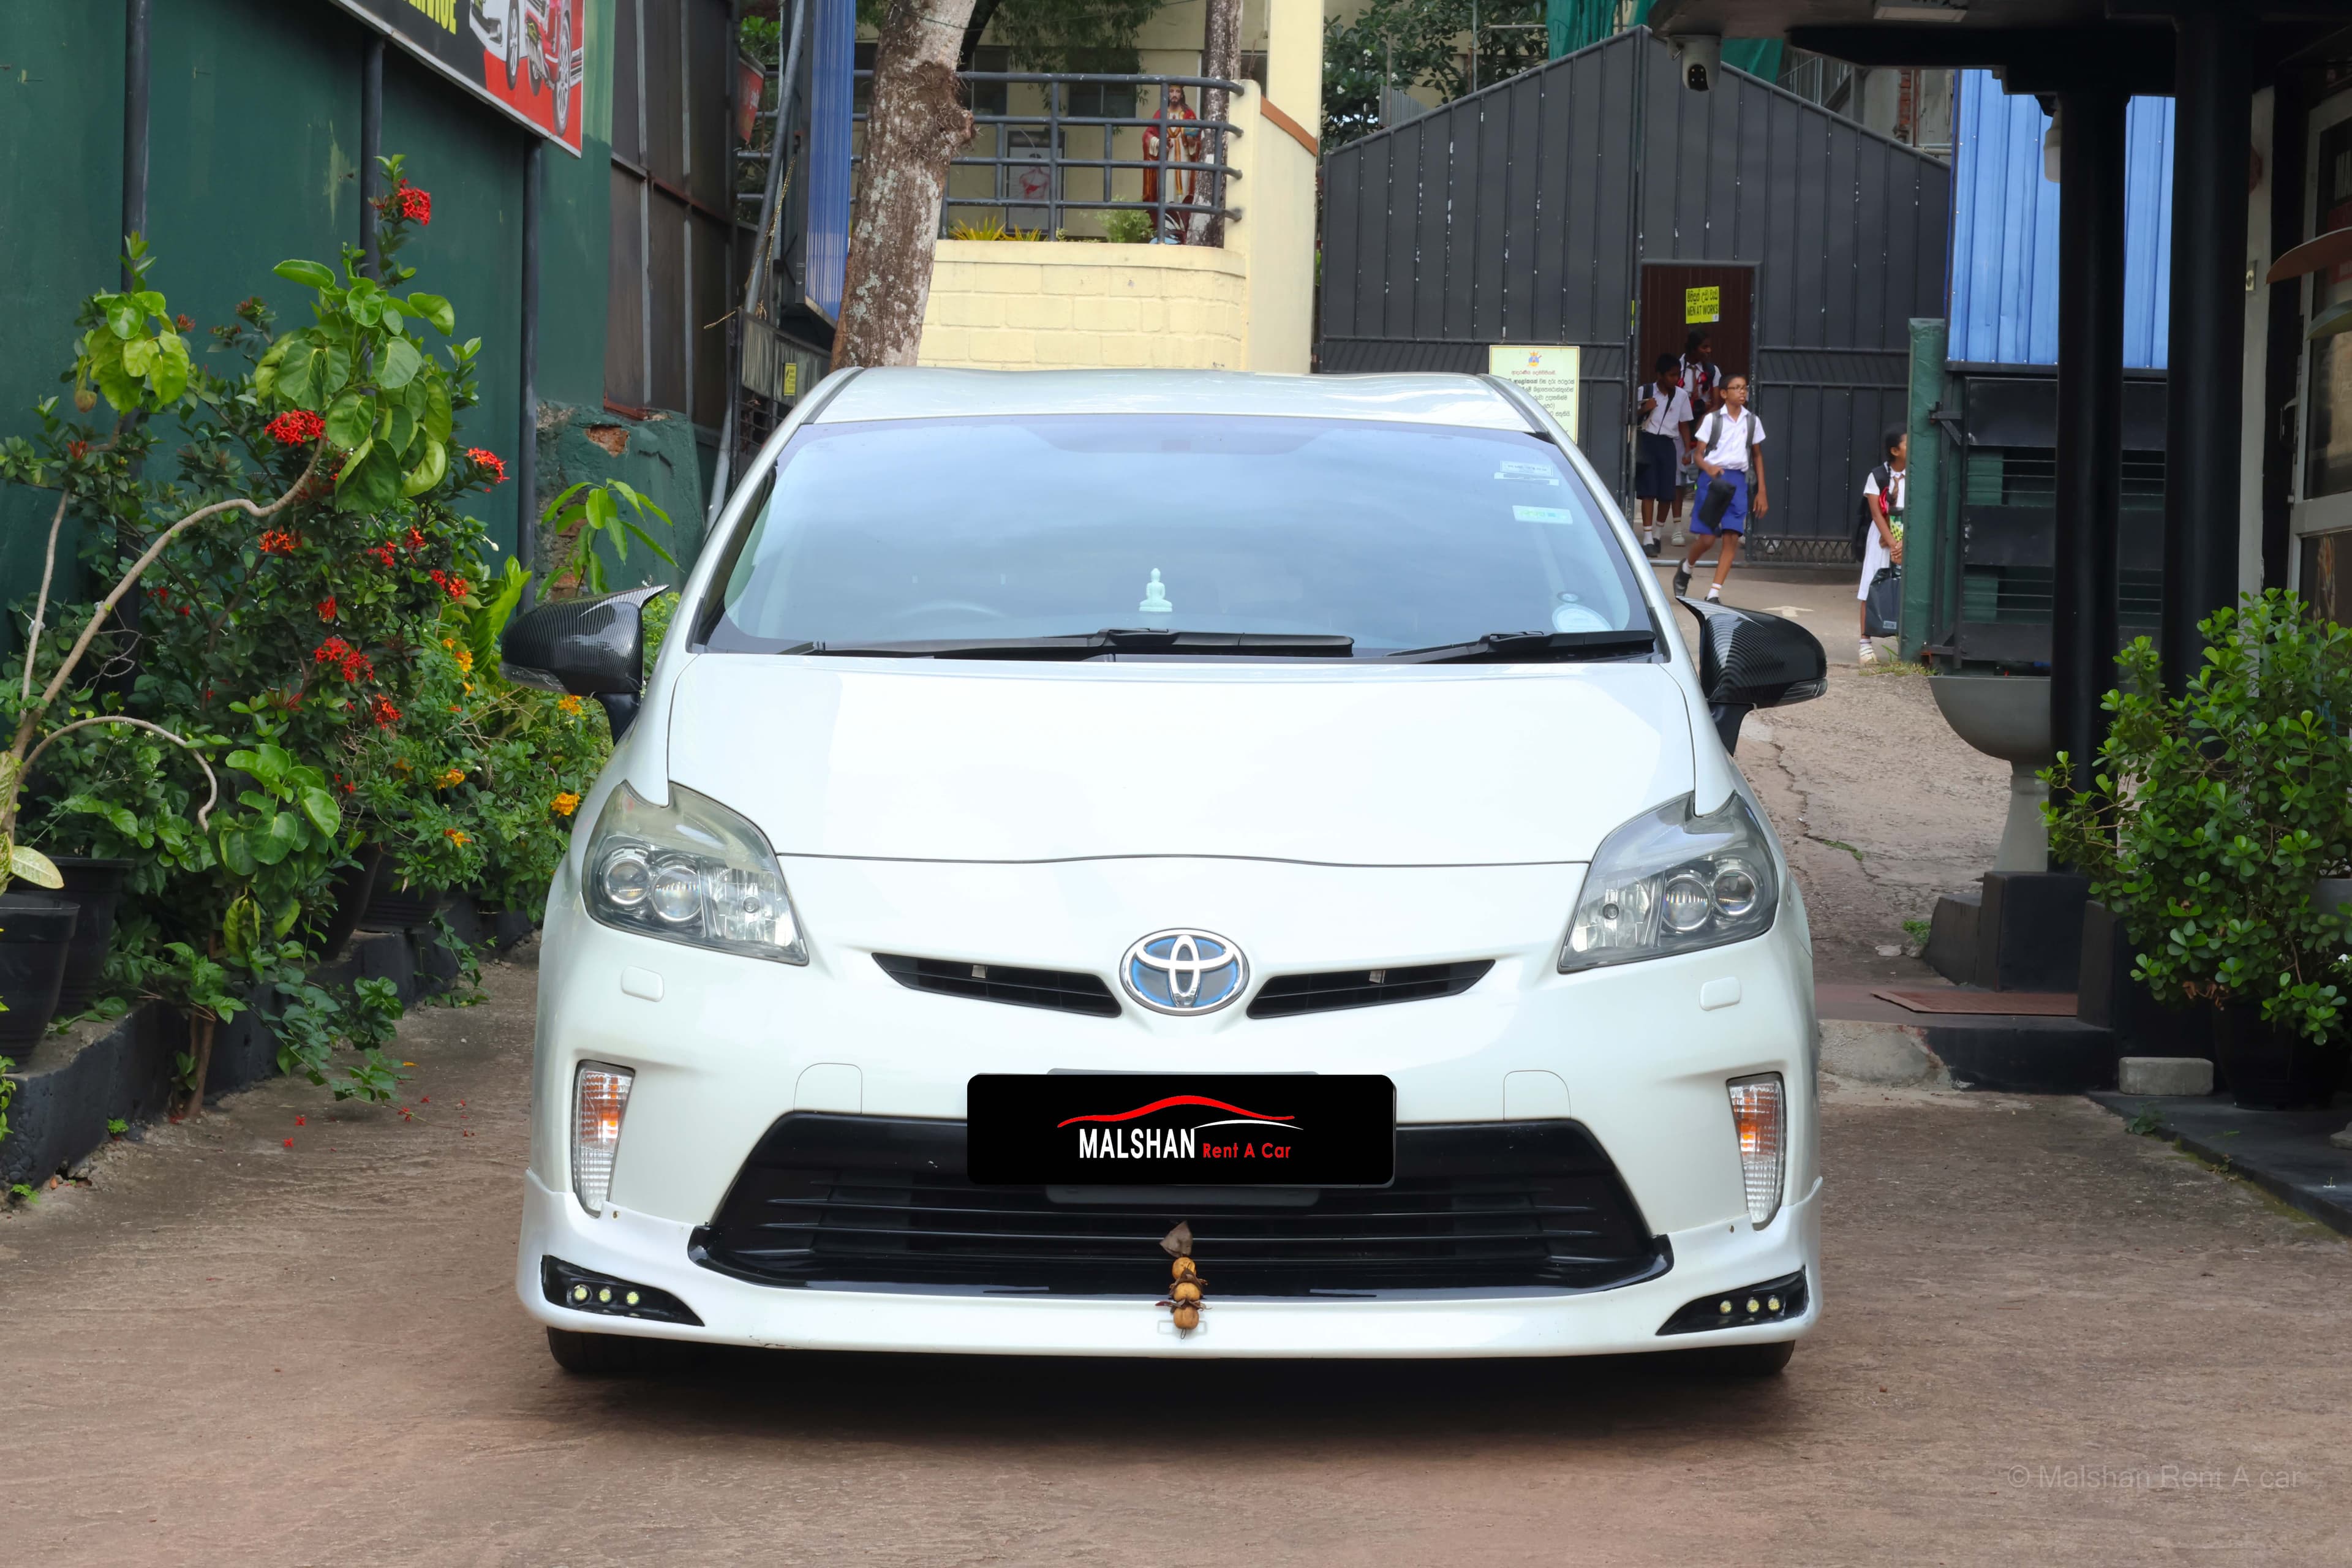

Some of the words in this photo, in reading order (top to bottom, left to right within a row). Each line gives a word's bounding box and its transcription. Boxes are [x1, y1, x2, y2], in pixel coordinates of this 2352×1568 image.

[1687, 306, 1696, 316] MEN
[1697, 305, 1702, 315] AT
[1703, 304, 1718, 315] WORKS
